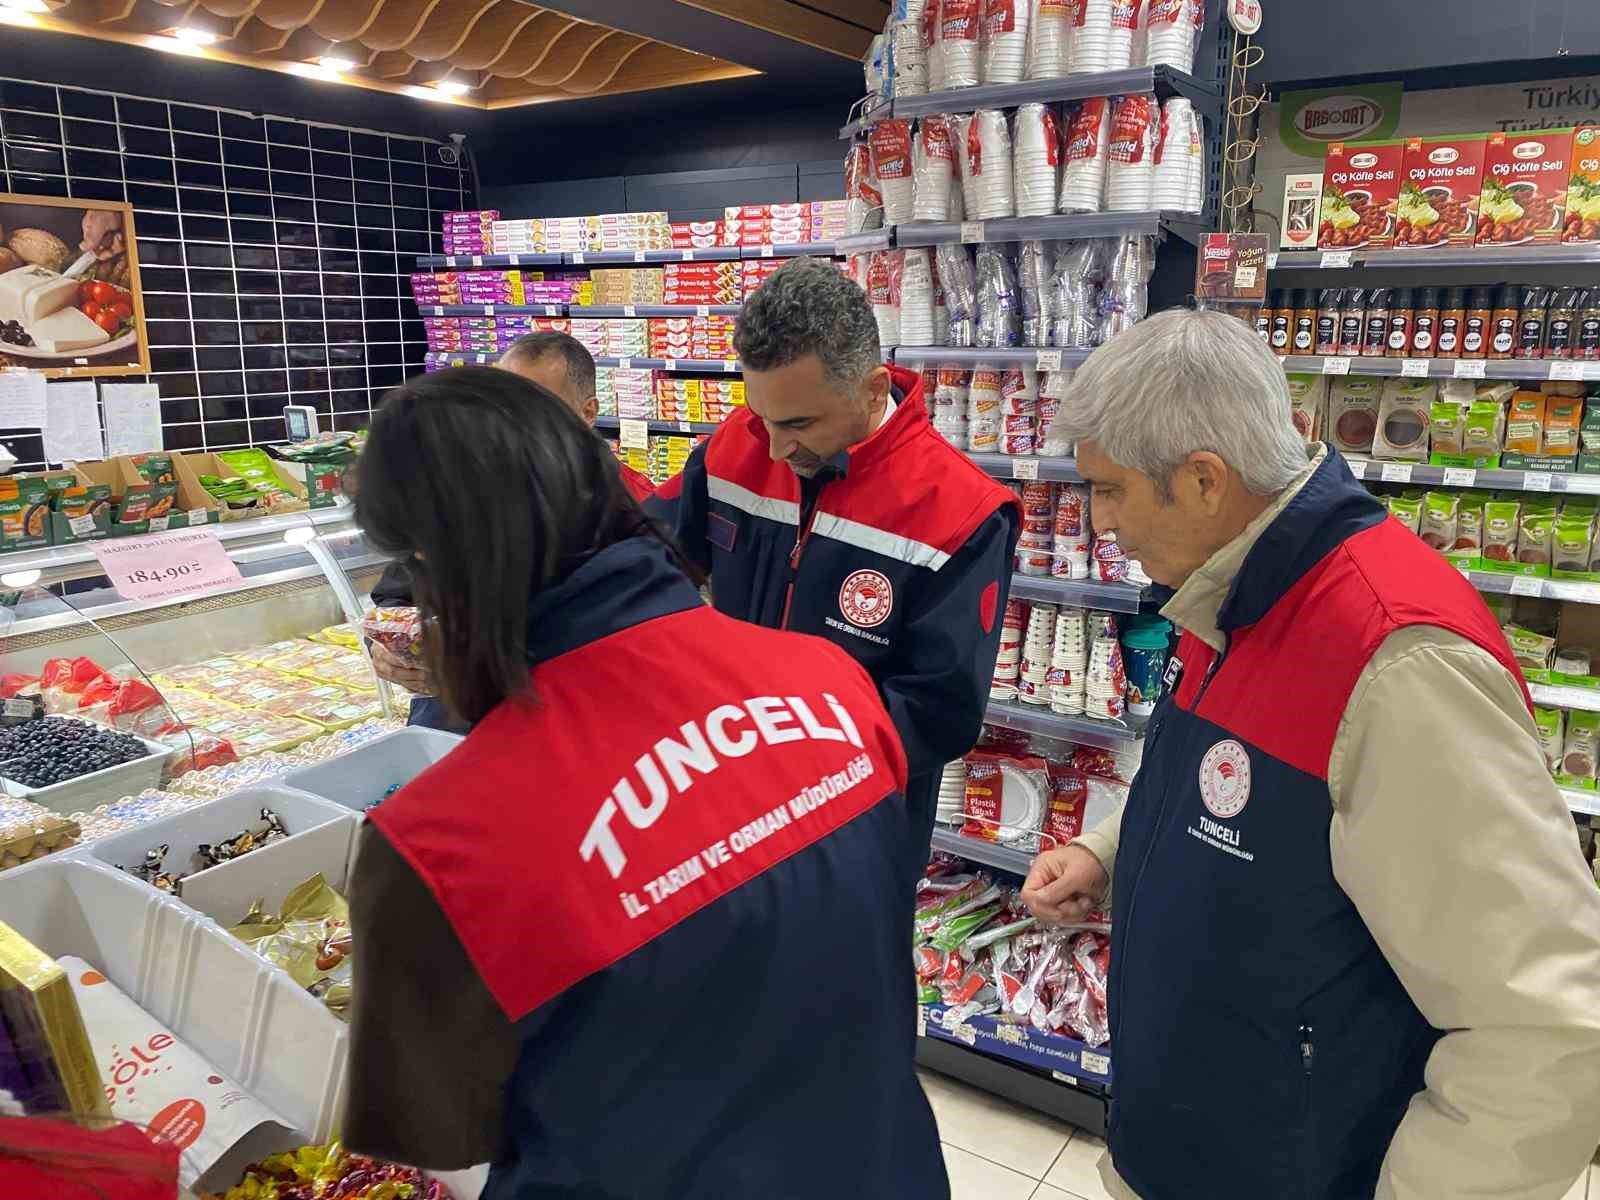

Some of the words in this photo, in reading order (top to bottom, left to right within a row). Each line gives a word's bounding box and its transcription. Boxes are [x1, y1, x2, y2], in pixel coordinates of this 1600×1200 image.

[1204, 246, 1232, 258] Nestlé
[1237, 246, 1263, 259] Yoğun
[579, 692, 865, 880] TUNCELİ
[619, 892, 650, 919] İL
[643, 856, 706, 904] TARIM
[701, 840, 733, 869] VE
[729, 804, 792, 854] ORMAN
[788, 752, 875, 820] MÜDÜRLÜĞÜ
[1199, 816, 1241, 847] TUNCELİ
